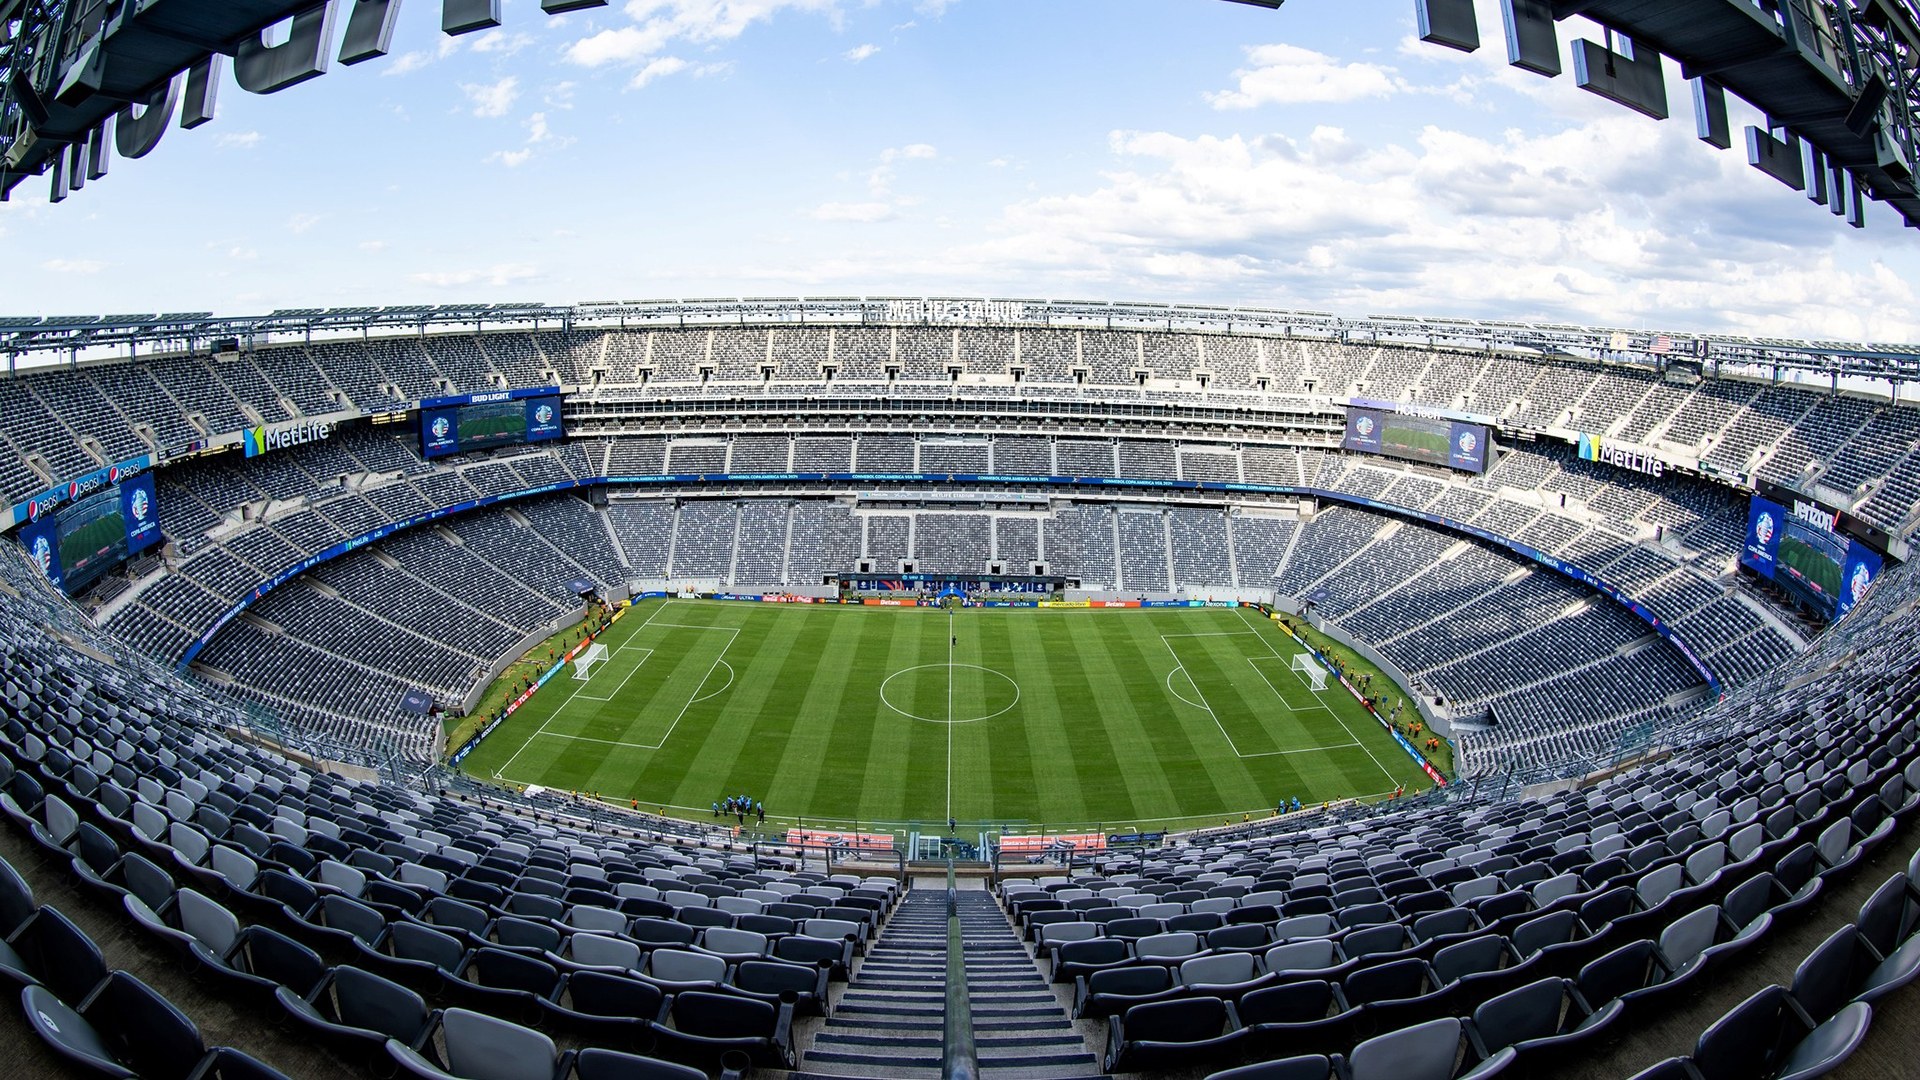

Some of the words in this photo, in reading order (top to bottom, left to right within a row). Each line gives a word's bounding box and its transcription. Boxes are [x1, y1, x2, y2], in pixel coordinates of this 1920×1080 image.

[471, 394, 488, 403] BUD
[488, 392, 511, 401] LIGHT
[265, 420, 330, 451] MetLife
[1600, 442, 1664, 477] MetLife
[119, 461, 141, 479] pepsi
[78, 474, 100, 495] pepsi
[38, 491, 59, 514] pepsi
[1793, 499, 1834, 533] verizon
[528, 683, 539, 695] TCL
[506, 704, 517, 715] TCL
[517, 695, 527, 705] TCL
